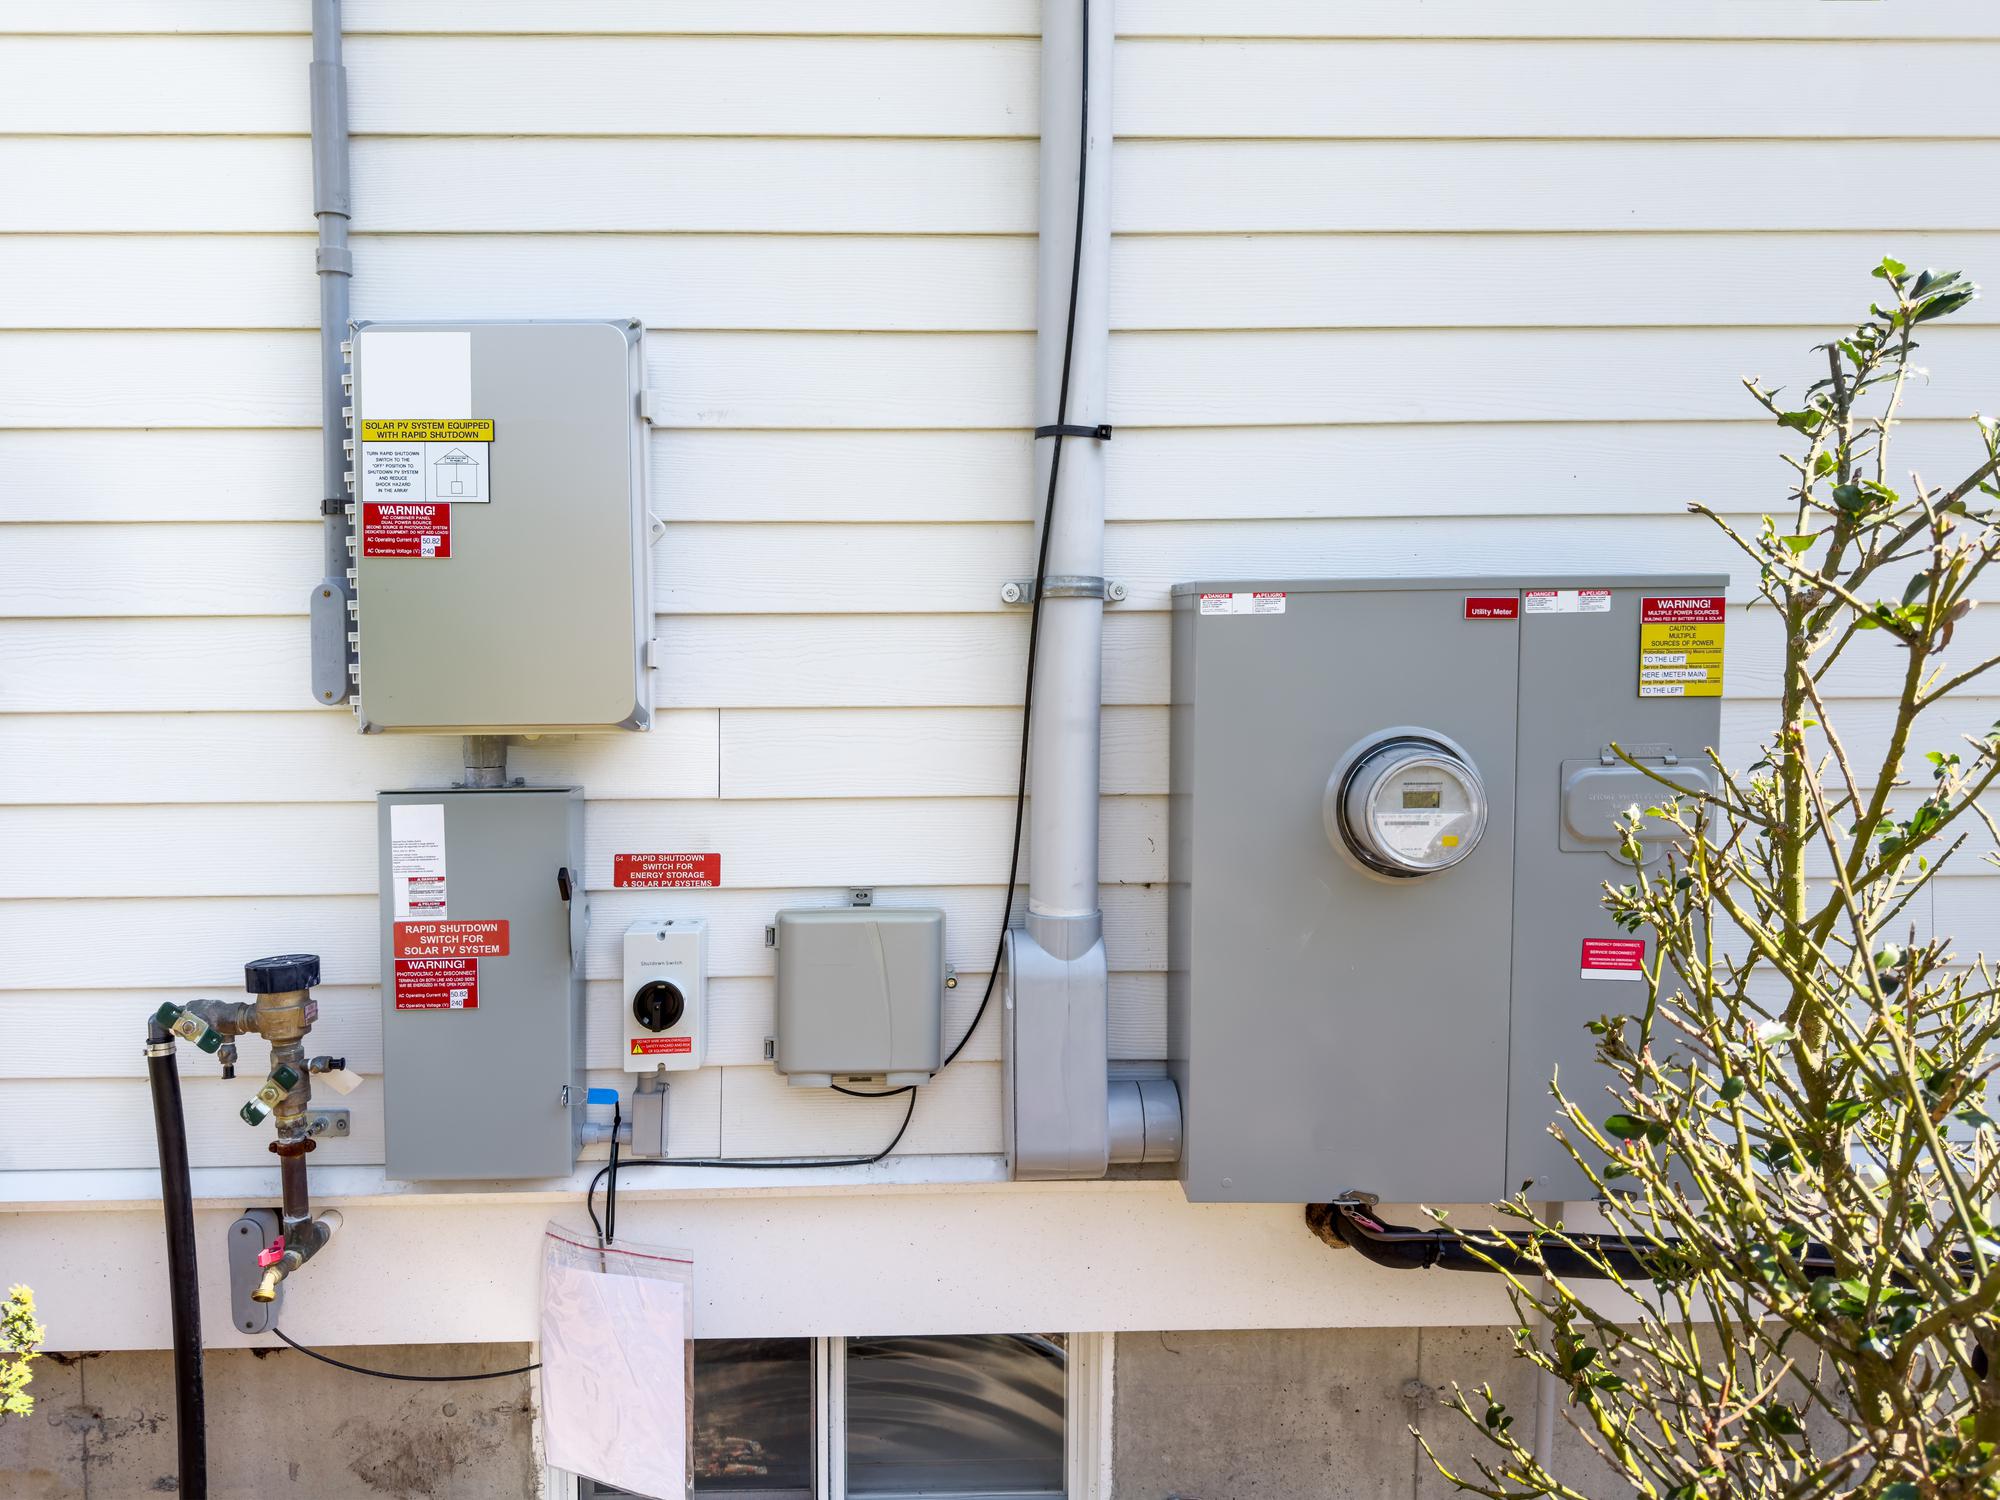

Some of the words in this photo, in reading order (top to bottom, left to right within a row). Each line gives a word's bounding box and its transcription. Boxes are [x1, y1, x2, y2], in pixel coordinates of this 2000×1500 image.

[378, 506, 435, 515] WARNING!
[1658, 600, 1711, 608] WARNING!
[1472, 608, 1491, 616] Utility
[406, 925, 436, 933] RAPID
[440, 924, 498, 932] SHUTDOWN
[420, 936, 459, 944] SWITCH
[404, 947, 439, 955] SOLAR
[460, 945, 500, 954] SYSTEM
[408, 960, 465, 969] WARNING!
